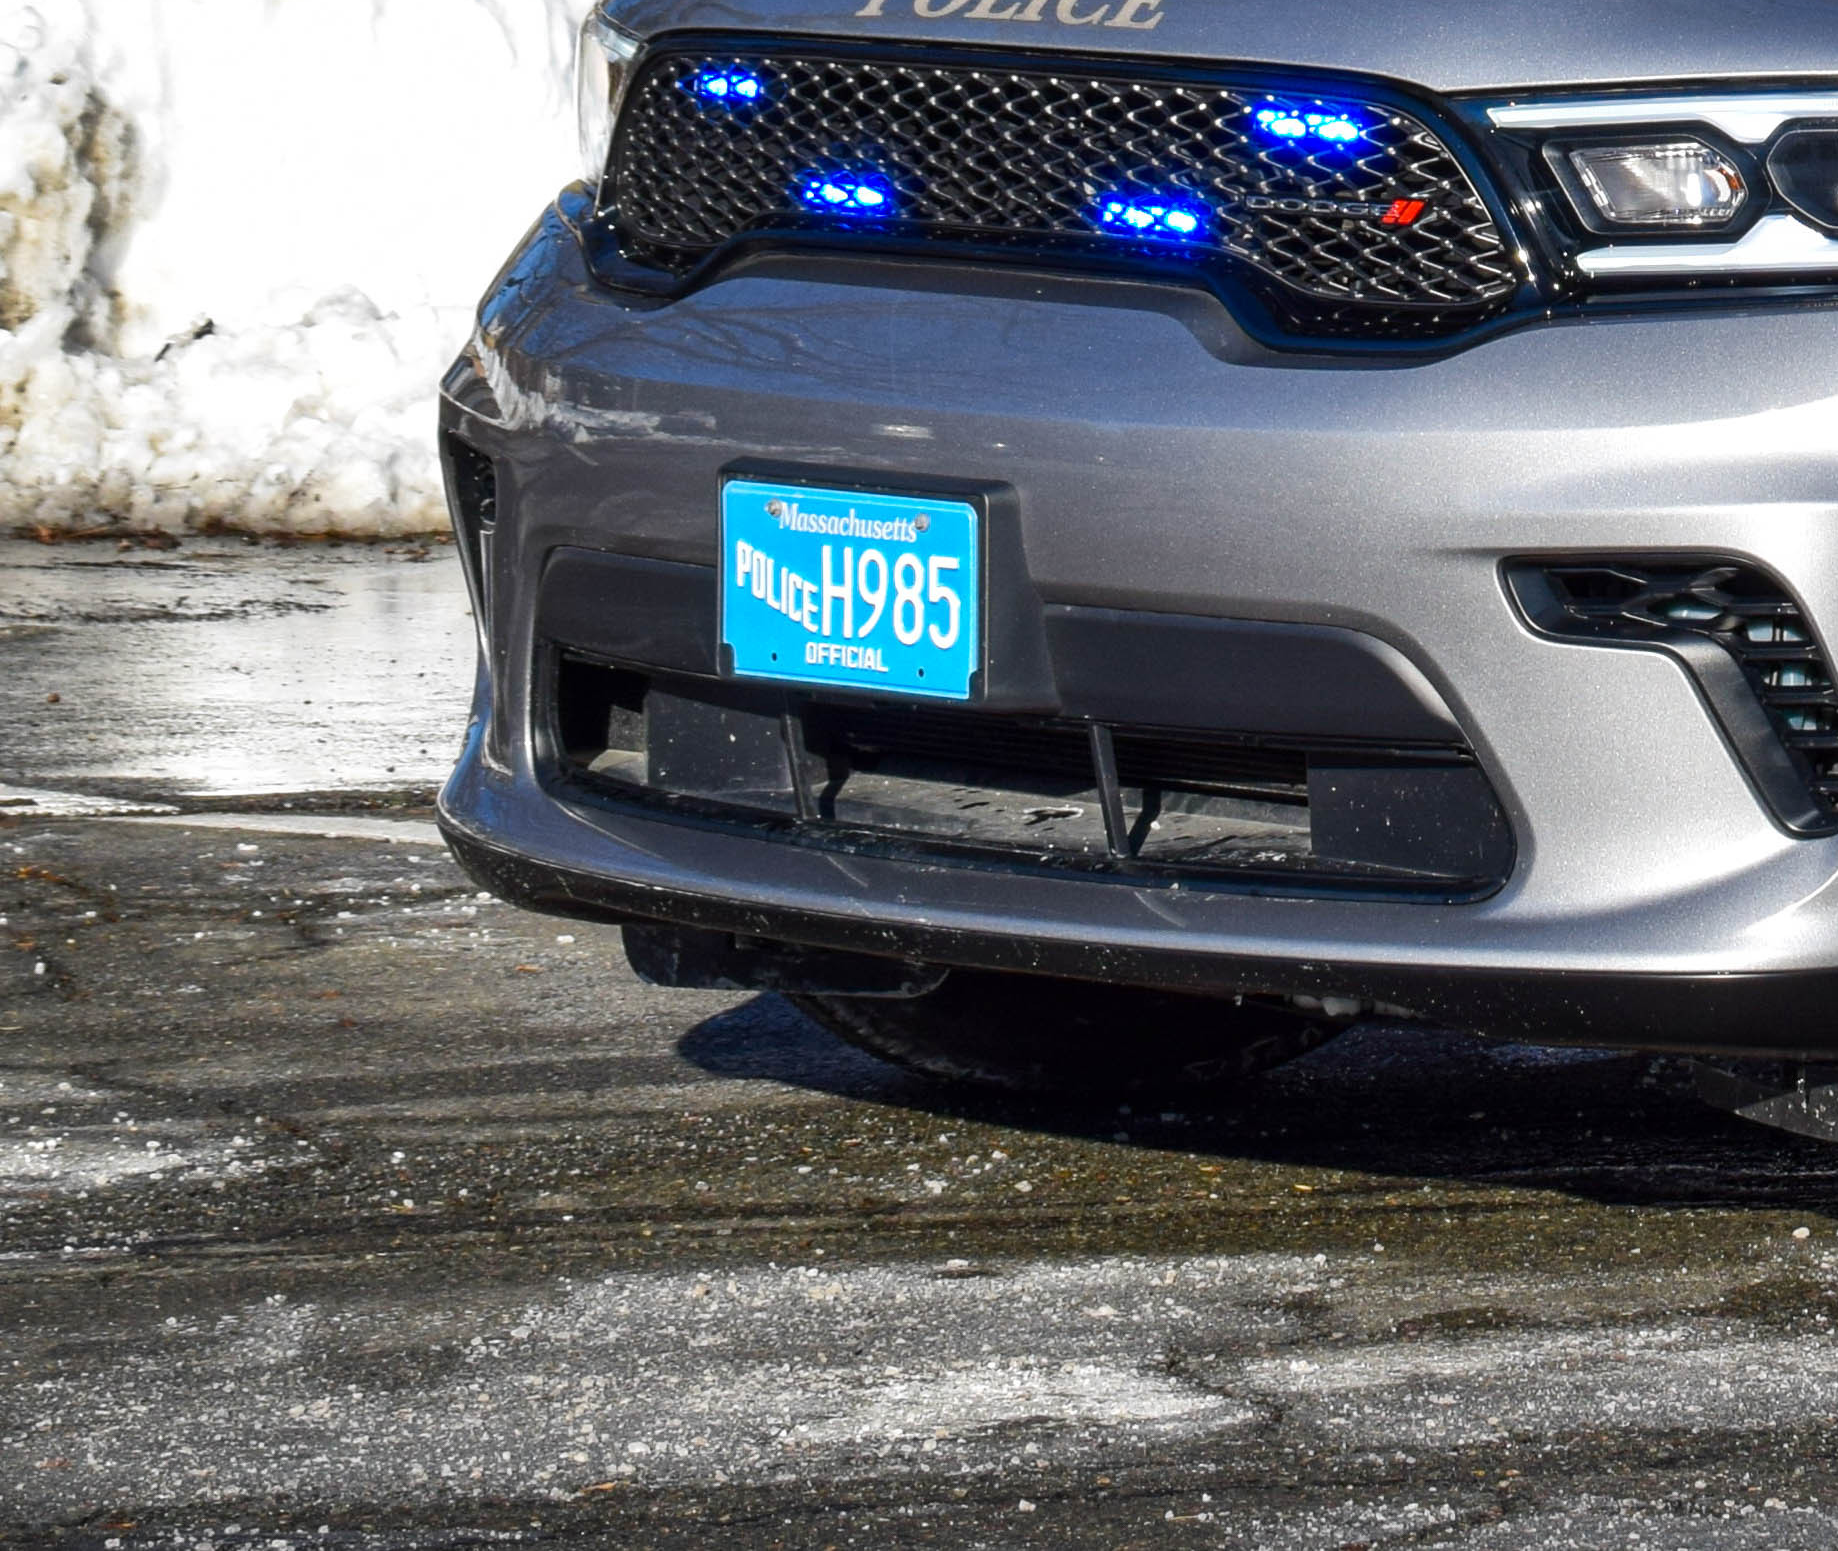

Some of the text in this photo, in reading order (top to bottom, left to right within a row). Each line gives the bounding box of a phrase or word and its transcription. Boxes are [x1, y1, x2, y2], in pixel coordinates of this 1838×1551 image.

[1246, 196, 1393, 217] DODGE
[778, 501, 917, 543] Massachusetts
[736, 539, 819, 633] POLICE
[822, 544, 961, 650] H985
[805, 641, 888, 673] OFFICIAL
